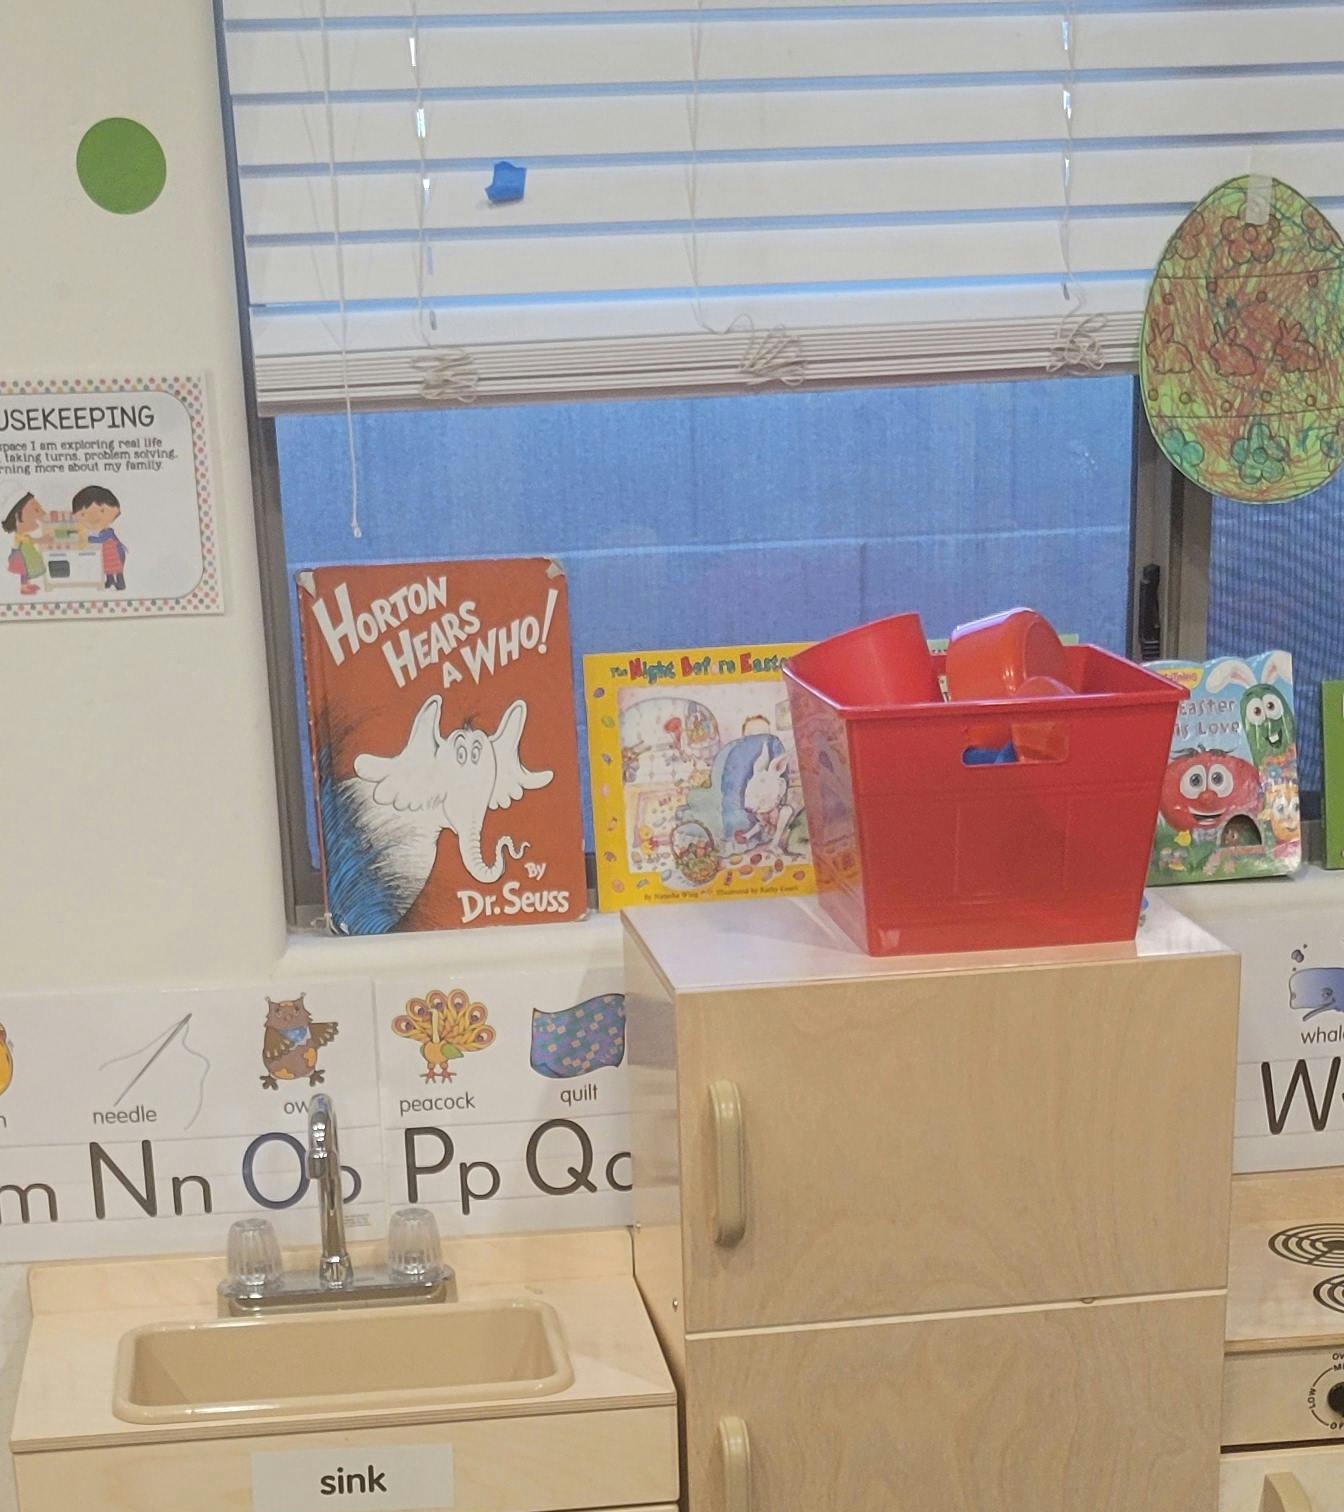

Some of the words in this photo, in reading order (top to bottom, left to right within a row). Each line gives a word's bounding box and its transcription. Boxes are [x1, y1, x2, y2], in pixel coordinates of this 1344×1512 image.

[5, 451, 42, 465] taking
[84, 449, 131, 462] problem
[31, 440, 36, 450] I
[39, 441, 57, 450] am
[60, 439, 114, 453] exploring
[118, 438, 140, 449] real
[143, 437, 163, 448] life
[34, 463, 65, 473] more
[67, 461, 99, 472] about
[103, 462, 121, 473] my
[311, 575, 447, 667] HORTON
[381, 600, 481, 689] HEARS
[442, 660, 463, 689] A
[460, 588, 559, 685] WHO!
[628, 657, 677, 684] Night
[680, 655, 736, 677] Before
[524, 862, 547, 881] By
[456, 890, 501, 924] Dr.
[501, 881, 570, 915] Seuss
[92, 1105, 157, 1124] needle
[283, 1101, 309, 1114] ow
[399, 1091, 475, 1115] peacock
[560, 1083, 599, 1106] quilt
[88, 1138, 212, 1219] Nn
[404, 1126, 501, 1216] Pp
[1307, 1387, 1317, 1409] LOW
[320, 1465, 387, 1495] sink
